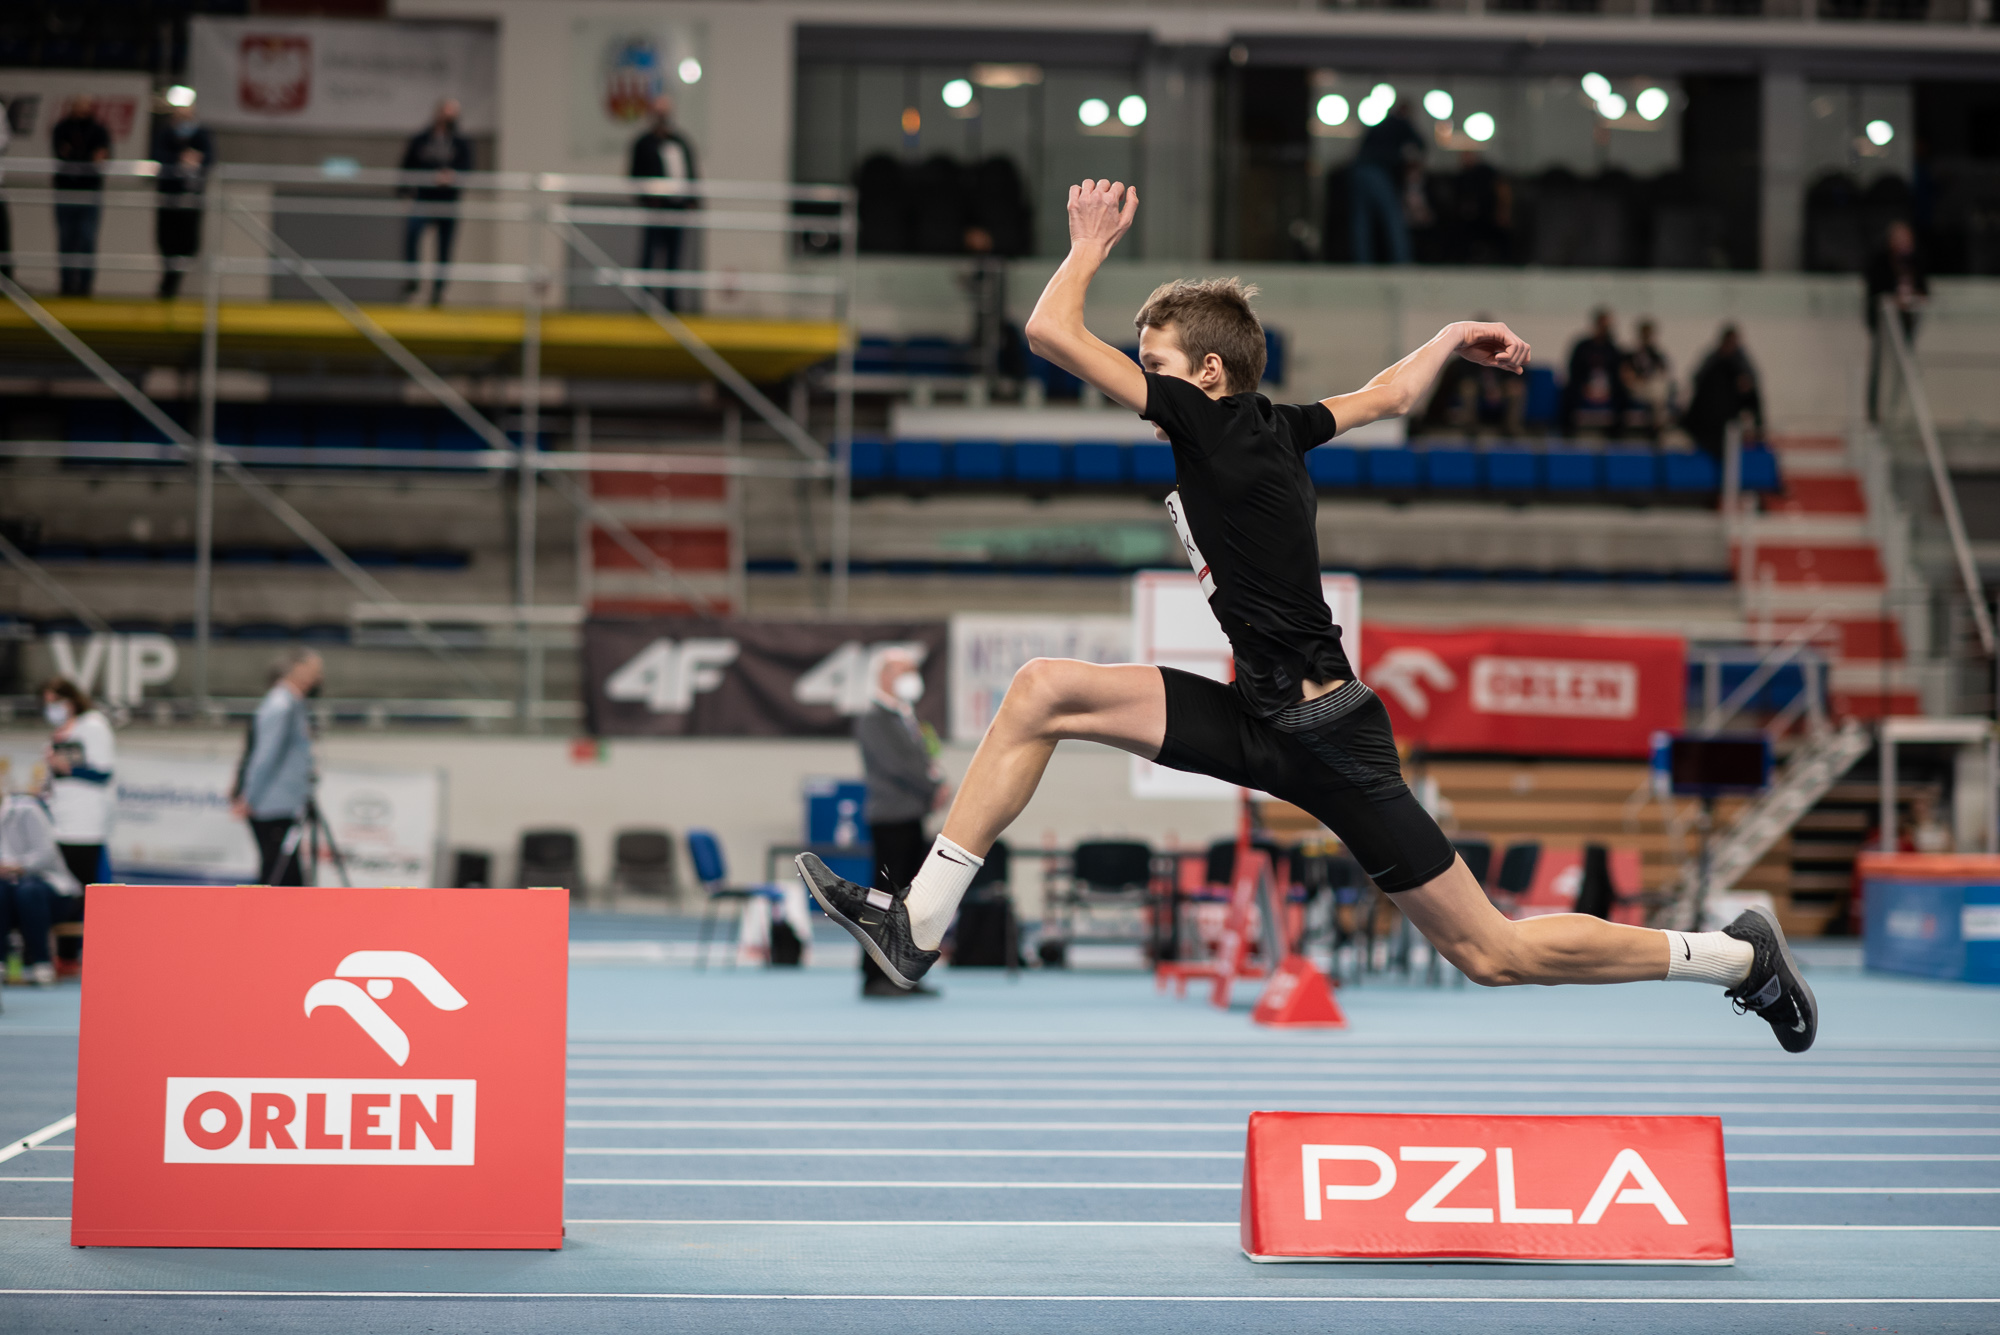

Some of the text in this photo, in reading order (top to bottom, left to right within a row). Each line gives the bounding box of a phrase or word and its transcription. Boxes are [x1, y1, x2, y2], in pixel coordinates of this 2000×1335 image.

[50, 631, 178, 706] VIP
[605, 636, 741, 714] 4F
[1487, 673, 1621, 700] ORLEN
[183, 1090, 454, 1151] ORLEN
[1301, 1143, 1689, 1226] PZLA
